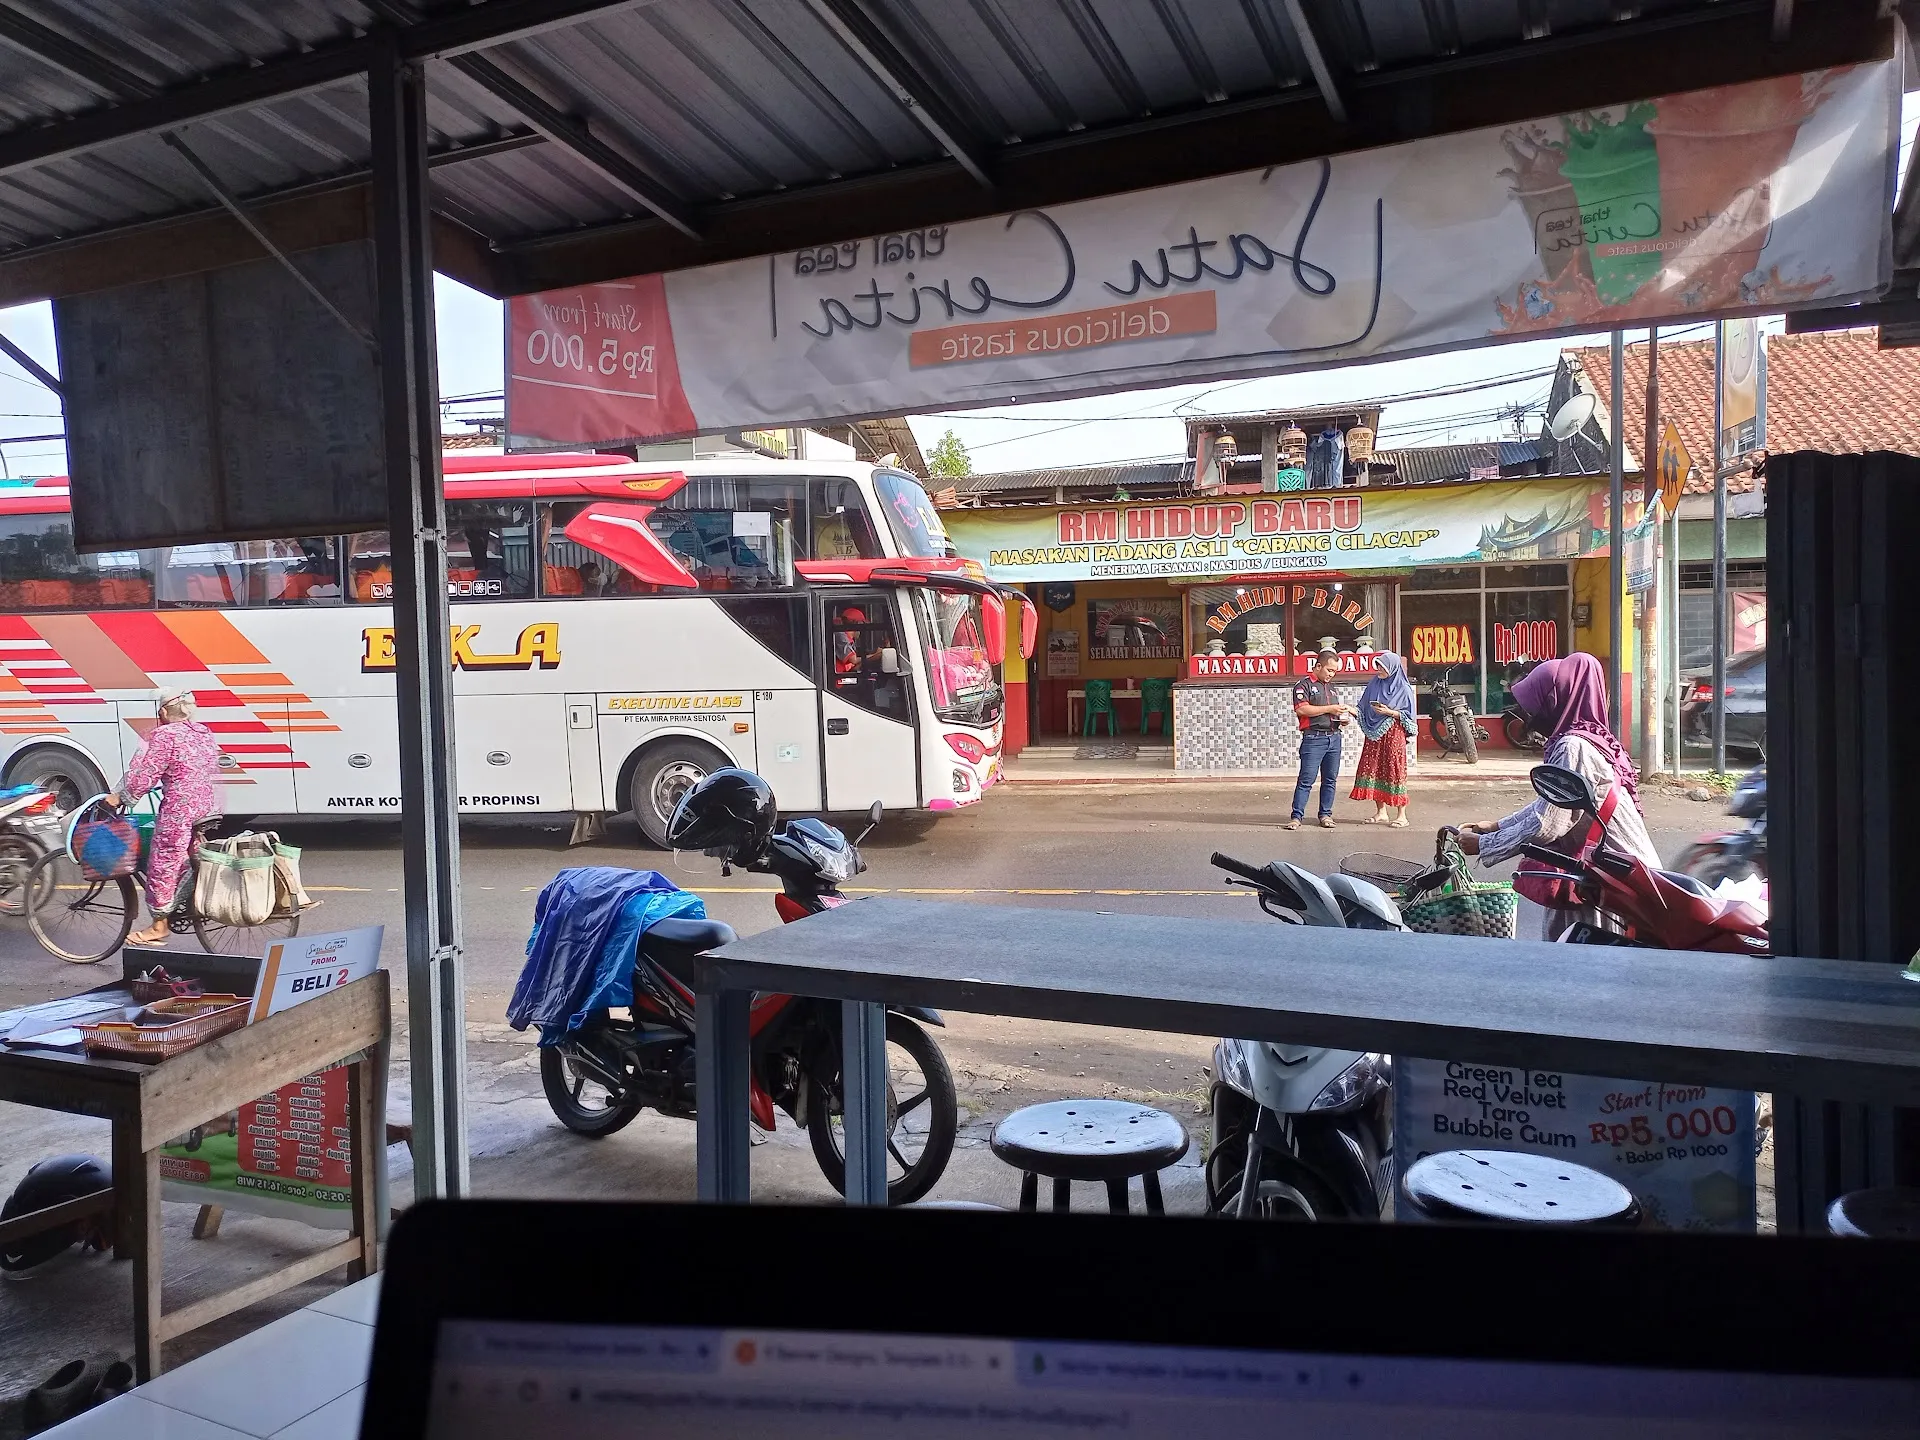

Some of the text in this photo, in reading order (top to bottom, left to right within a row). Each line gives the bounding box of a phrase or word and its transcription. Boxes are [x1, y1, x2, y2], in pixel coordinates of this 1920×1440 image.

[1058, 496, 1363, 545] RM HIDUP BARU
[990, 547, 1090, 566] MASAKAN
[1094, 543, 1176, 562] PADANG
[1181, 540, 1228, 558] ASLI
[1091, 564, 1149, 576] MENERIMA
[1151, 562, 1202, 574] PESANAN
[1210, 559, 1237, 571] NASI
[1238, 557, 1261, 570] DUS
[1272, 555, 1327, 568] BUNGKUS
[1311, 588, 1375, 631] BARU
[1090, 646, 1130, 659] SELAMAT
[1411, 624, 1474, 665] SERBA
[1197, 657, 1279, 675] MASAKAN
[608, 695, 742, 710] EXECUTIVE CLASS
[635, 715, 650, 723] EKA
[693, 714, 727, 722] SENTOSA
[327, 796, 403, 807] ANTAR KO
[473, 795, 540, 806] PROPINSI
[310, 955, 337, 966] PROMO
[291, 968, 349, 993] BELI 2
[1445, 1061, 1562, 1088] Green Tea
[1443, 1079, 1567, 1109] Red Velvet
[1600, 1081, 1706, 1115] Start from
[1478, 1100, 1530, 1124] Taro
[1433, 1113, 1576, 1148] Bubble Gum
[1588, 1105, 1737, 1147] Rp5.000
[1625, 1151, 1664, 1165] Boba
[1667, 1147, 1688, 1160] Rp
[1691, 1144, 1728, 1157] 1000
